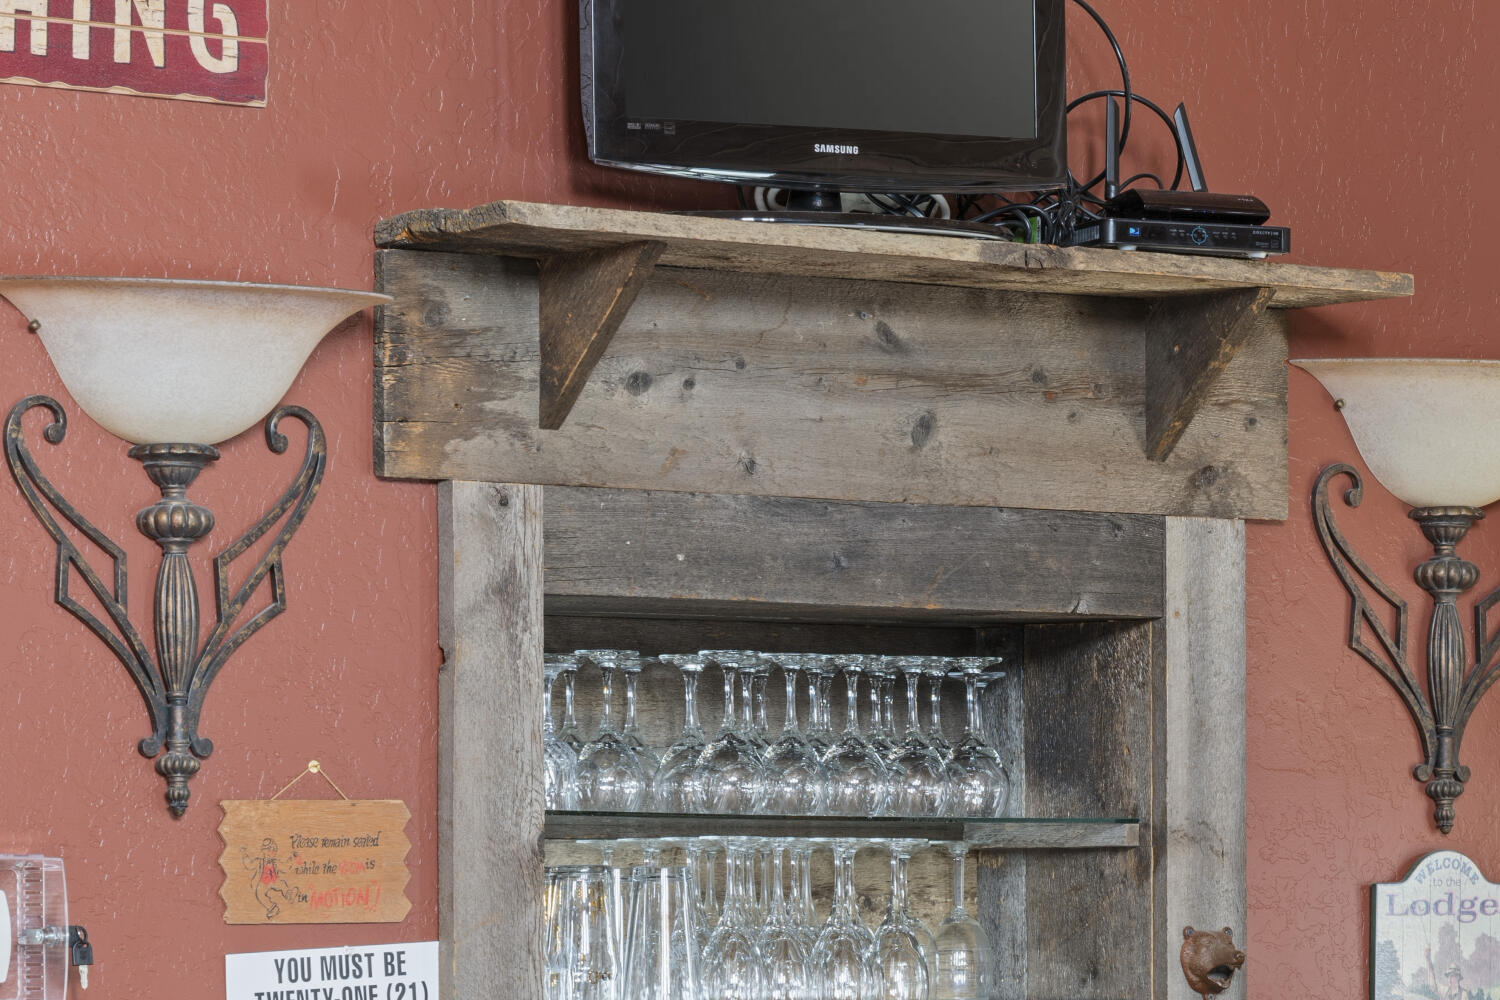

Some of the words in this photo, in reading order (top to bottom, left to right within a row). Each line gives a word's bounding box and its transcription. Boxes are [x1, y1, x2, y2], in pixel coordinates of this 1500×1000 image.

[814, 143, 859, 155] SAMSUNG
[290, 833, 319, 849] Please
[321, 836, 350, 848] remain
[353, 831, 382, 848] seated
[295, 861, 320, 874] while
[322, 858, 338, 874] the
[365, 857, 376, 870] is
[1415, 857, 1480, 885] WELCOME
[1433, 878, 1443, 887] to
[1446, 876, 1462, 887] the
[298, 890, 309, 903] in
[274, 956, 312, 984] YOU
[320, 951, 375, 981] MUST
[383, 950, 407, 977] BE
